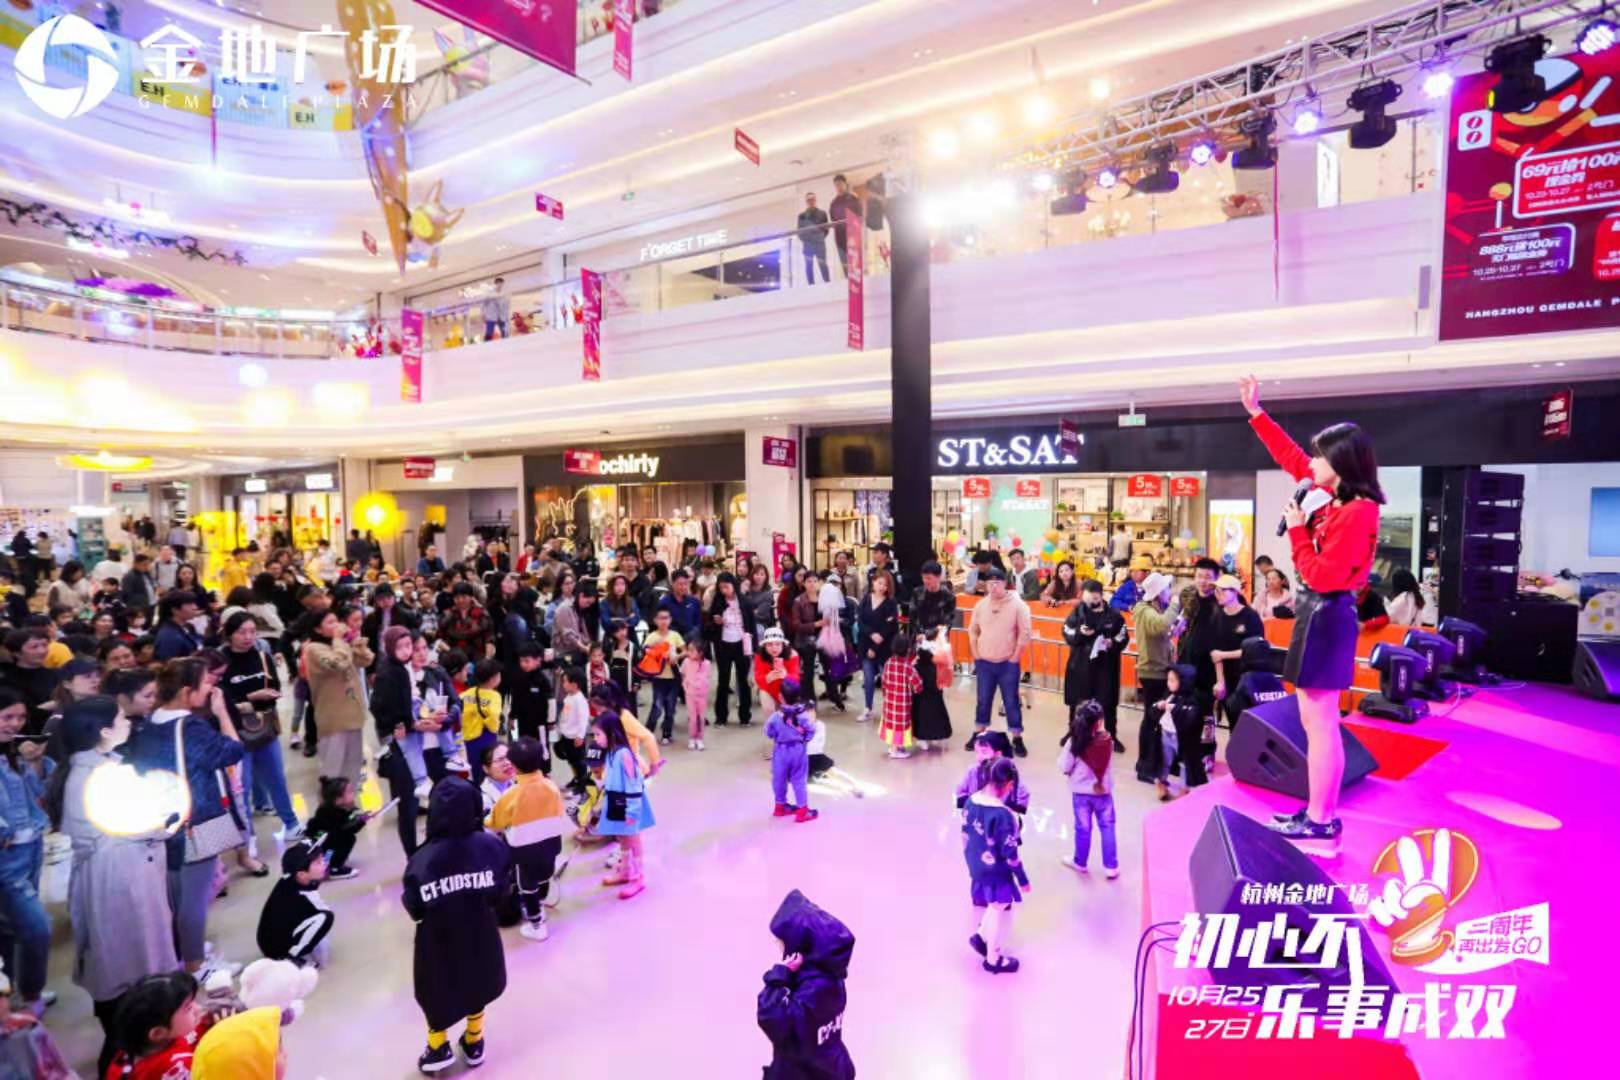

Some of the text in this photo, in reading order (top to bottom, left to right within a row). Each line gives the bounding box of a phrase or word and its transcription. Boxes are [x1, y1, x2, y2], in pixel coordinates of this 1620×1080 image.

[1465, 305, 1534, 319] HANGZHOU
[1539, 299, 1602, 313] GEMDALE
[599, 452, 659, 477] ochirly
[420, 870, 495, 902] CT-KIDSTAR
